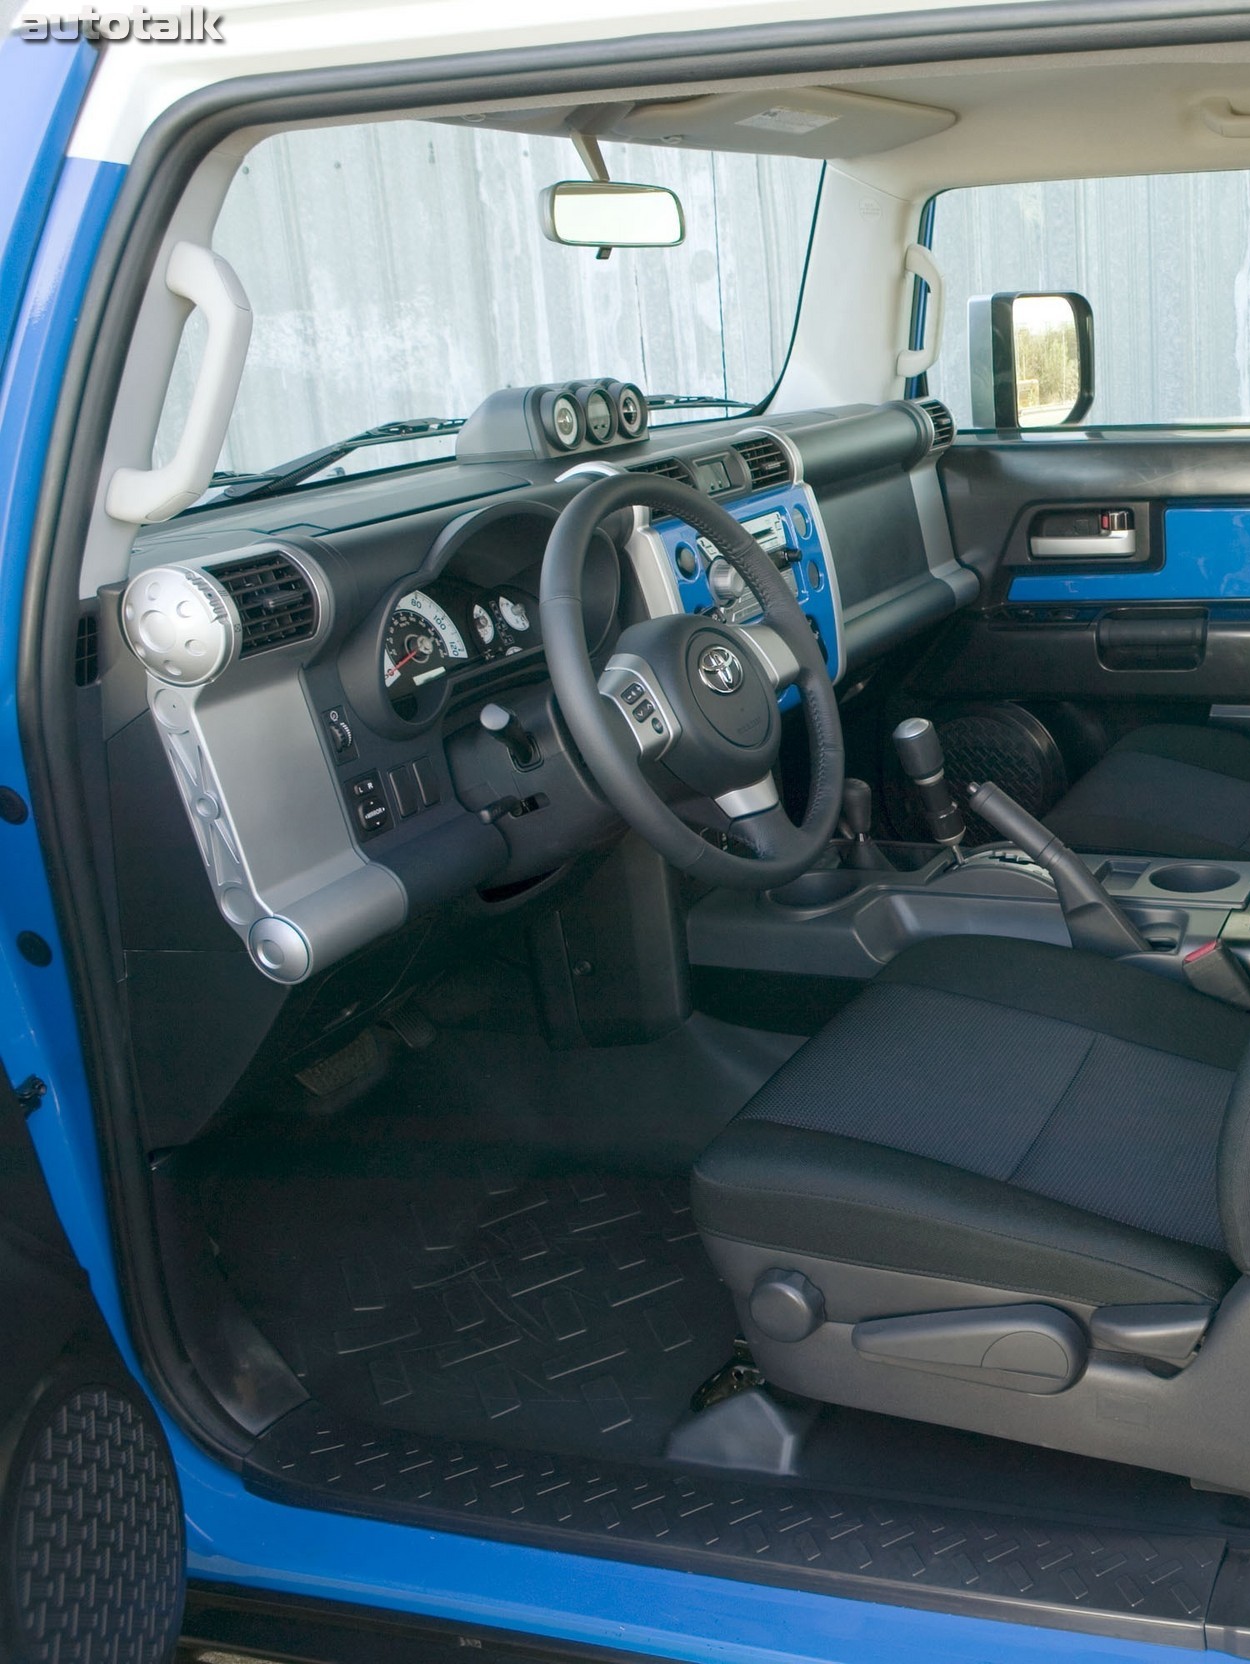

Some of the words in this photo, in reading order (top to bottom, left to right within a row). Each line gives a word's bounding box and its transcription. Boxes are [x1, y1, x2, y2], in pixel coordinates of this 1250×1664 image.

[410, 598, 422, 609] 80
[433, 614, 447, 631] 100
[449, 641, 459, 657] 120
